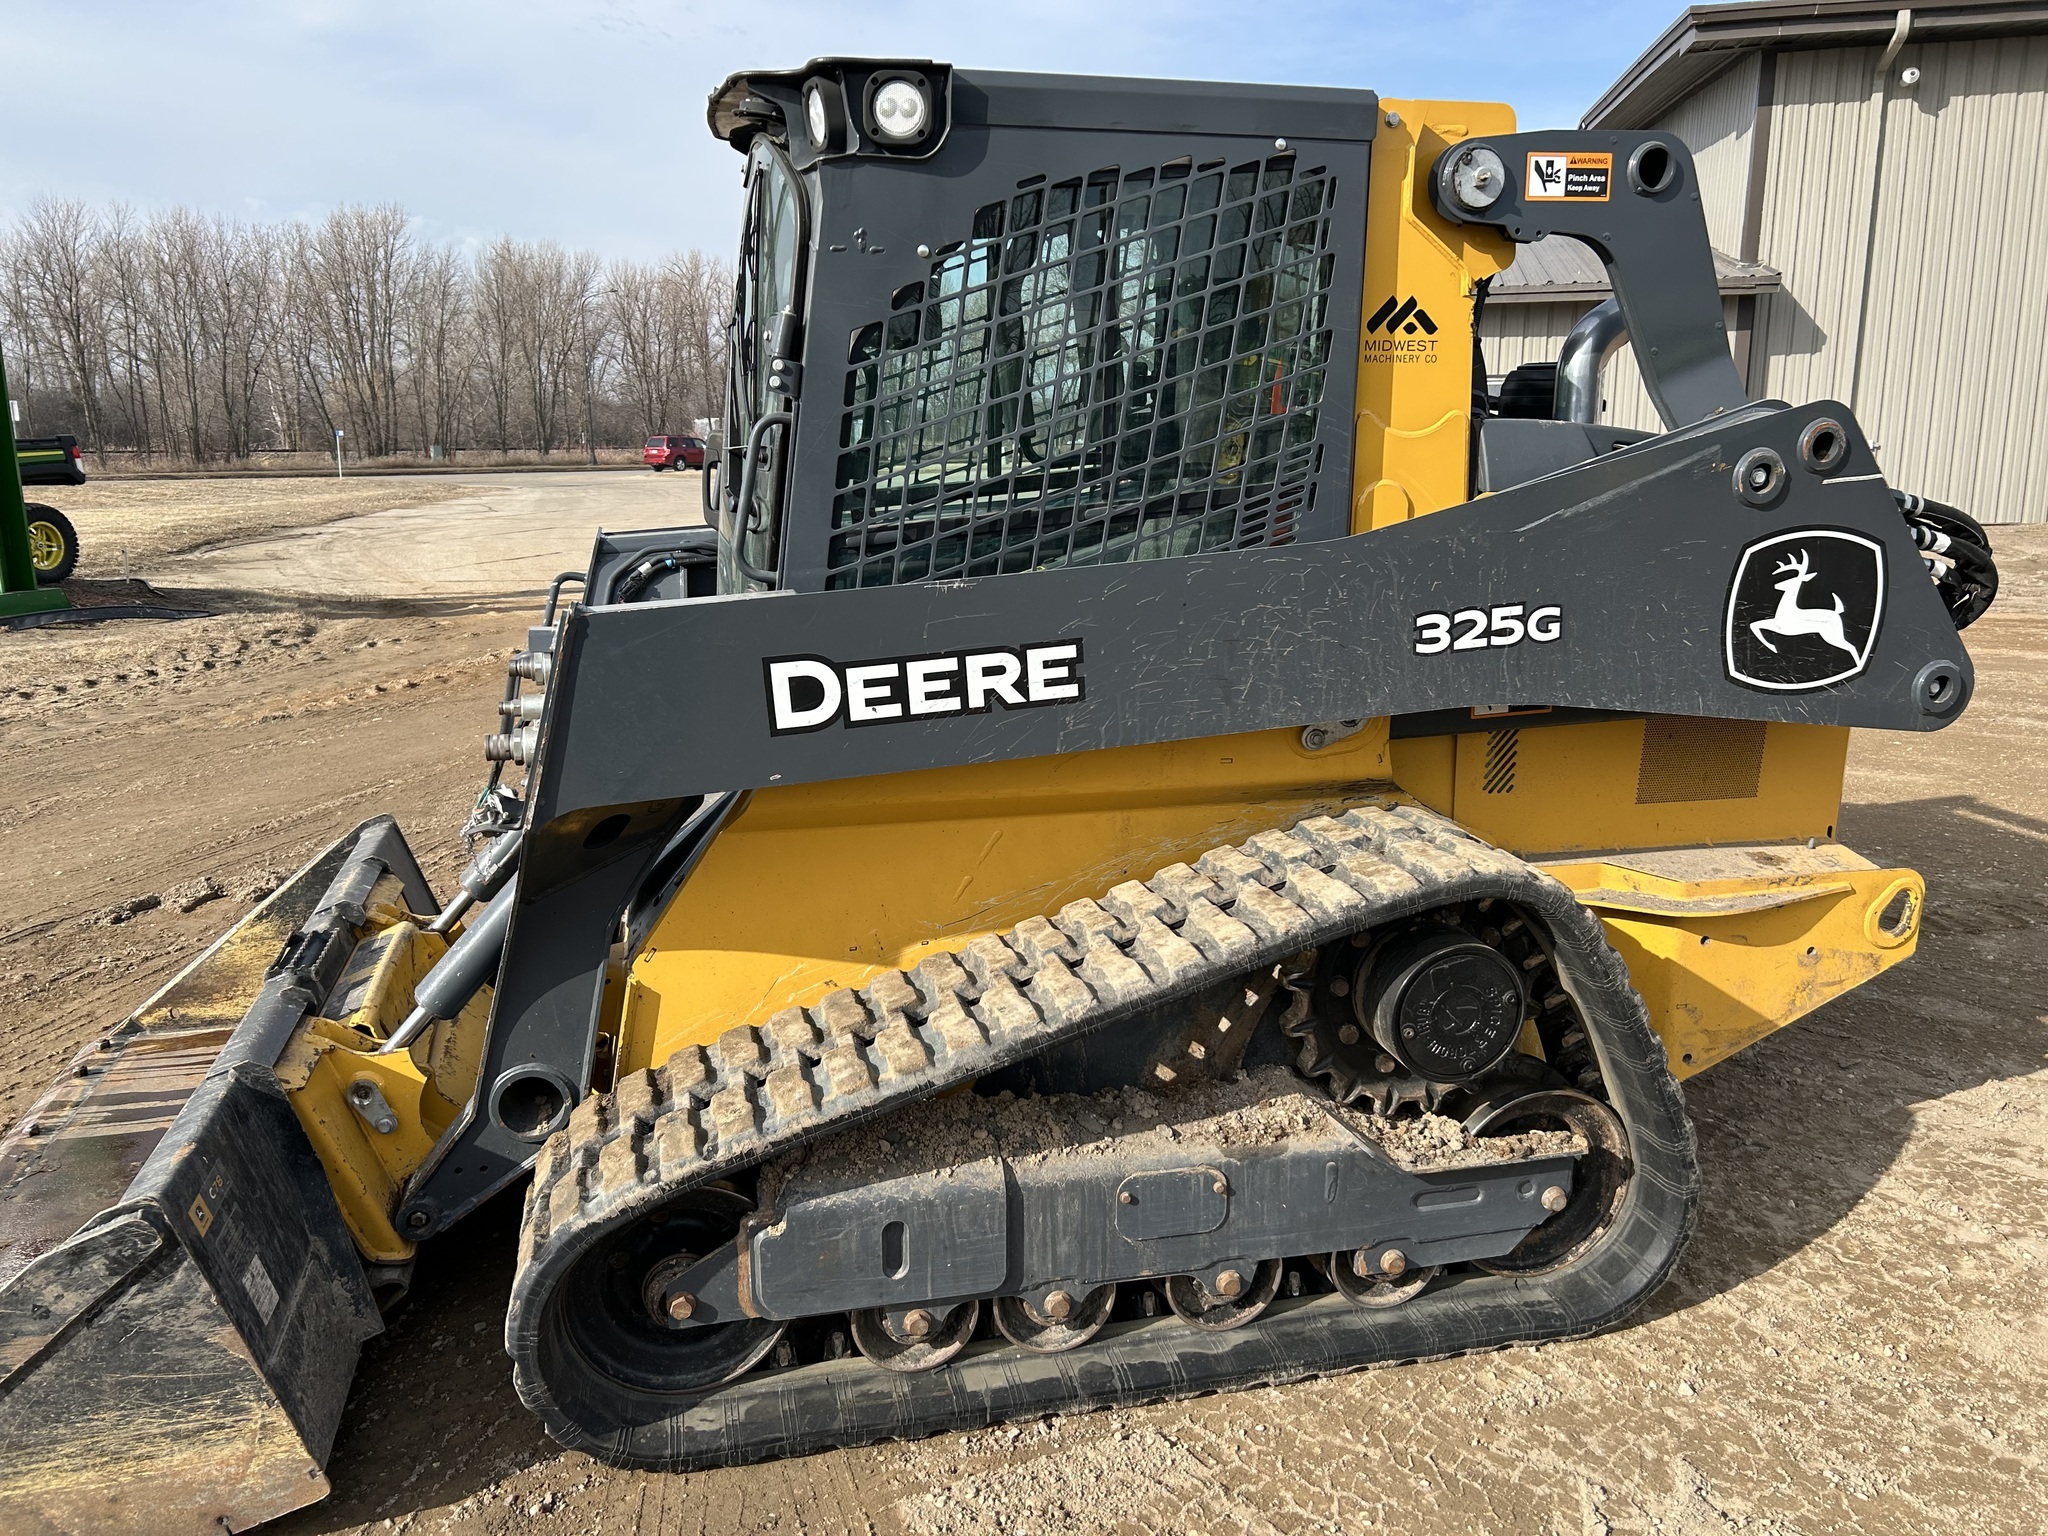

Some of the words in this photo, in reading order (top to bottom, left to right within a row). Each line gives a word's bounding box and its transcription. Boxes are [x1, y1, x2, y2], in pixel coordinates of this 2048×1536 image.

[1576, 157, 1608, 165] WARNING
[1567, 173, 1588, 182] Pinch
[1588, 174, 1606, 182] Area
[1567, 184, 1583, 192] Keep
[1583, 184, 1600, 193] Away
[1364, 340, 1438, 352] MIDWEST
[1364, 354, 1420, 364] MACHINERY
[1424, 354, 1438, 364] CO
[1415, 604, 1561, 654] 325G
[769, 644, 1079, 730] DEERE
[208, 1174, 223, 1199] C78
